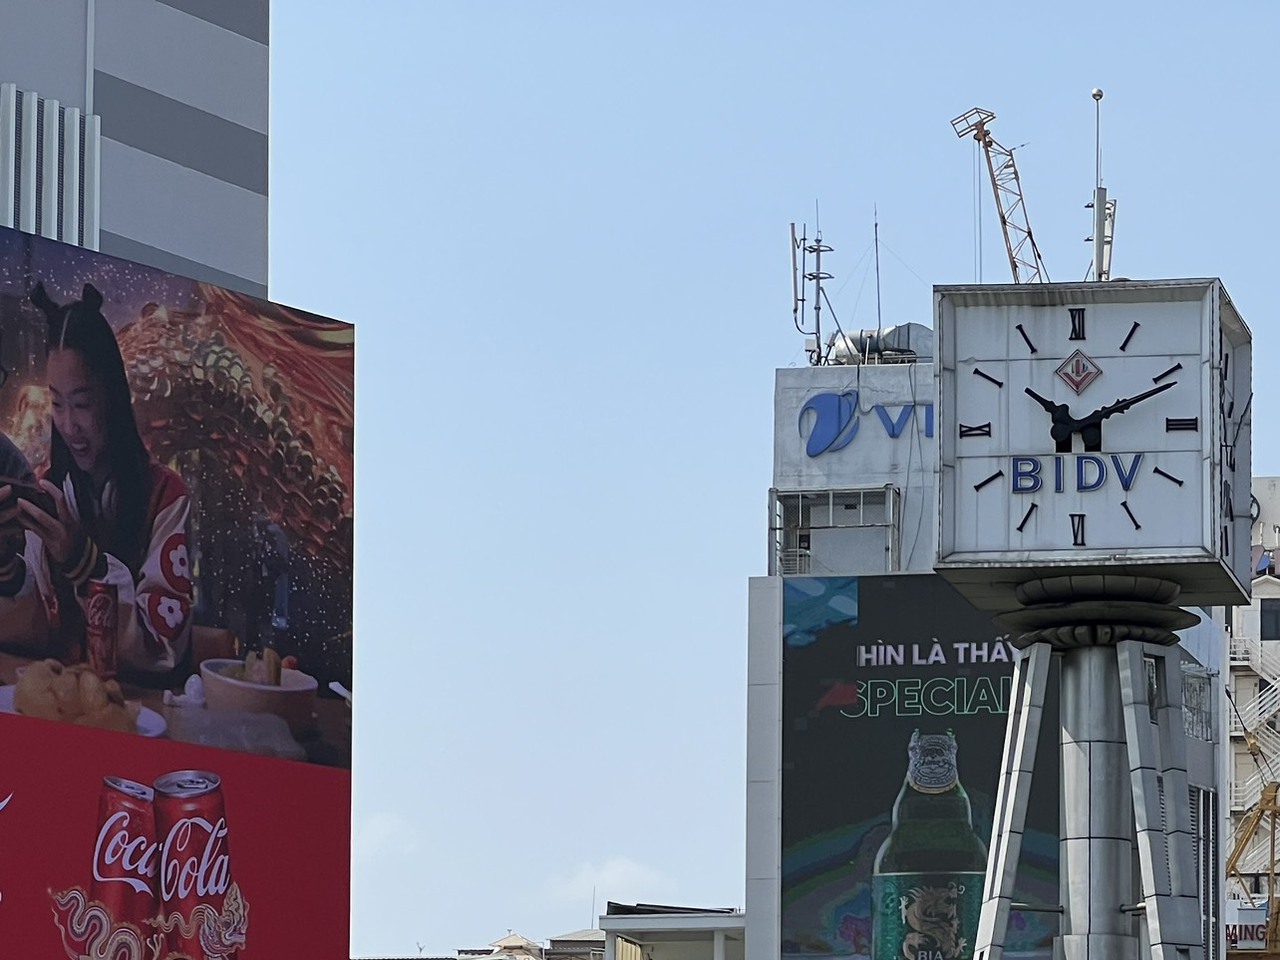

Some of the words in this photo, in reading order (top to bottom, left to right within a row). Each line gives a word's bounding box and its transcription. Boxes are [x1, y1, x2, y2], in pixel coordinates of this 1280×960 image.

[1011, 453, 1144, 494] BIDV
[856, 638, 905, 667] HÌN
[912, 637, 947, 666] LÀ
[93, 811, 162, 898] Coca
[160, 816, 231, 902] Cola
